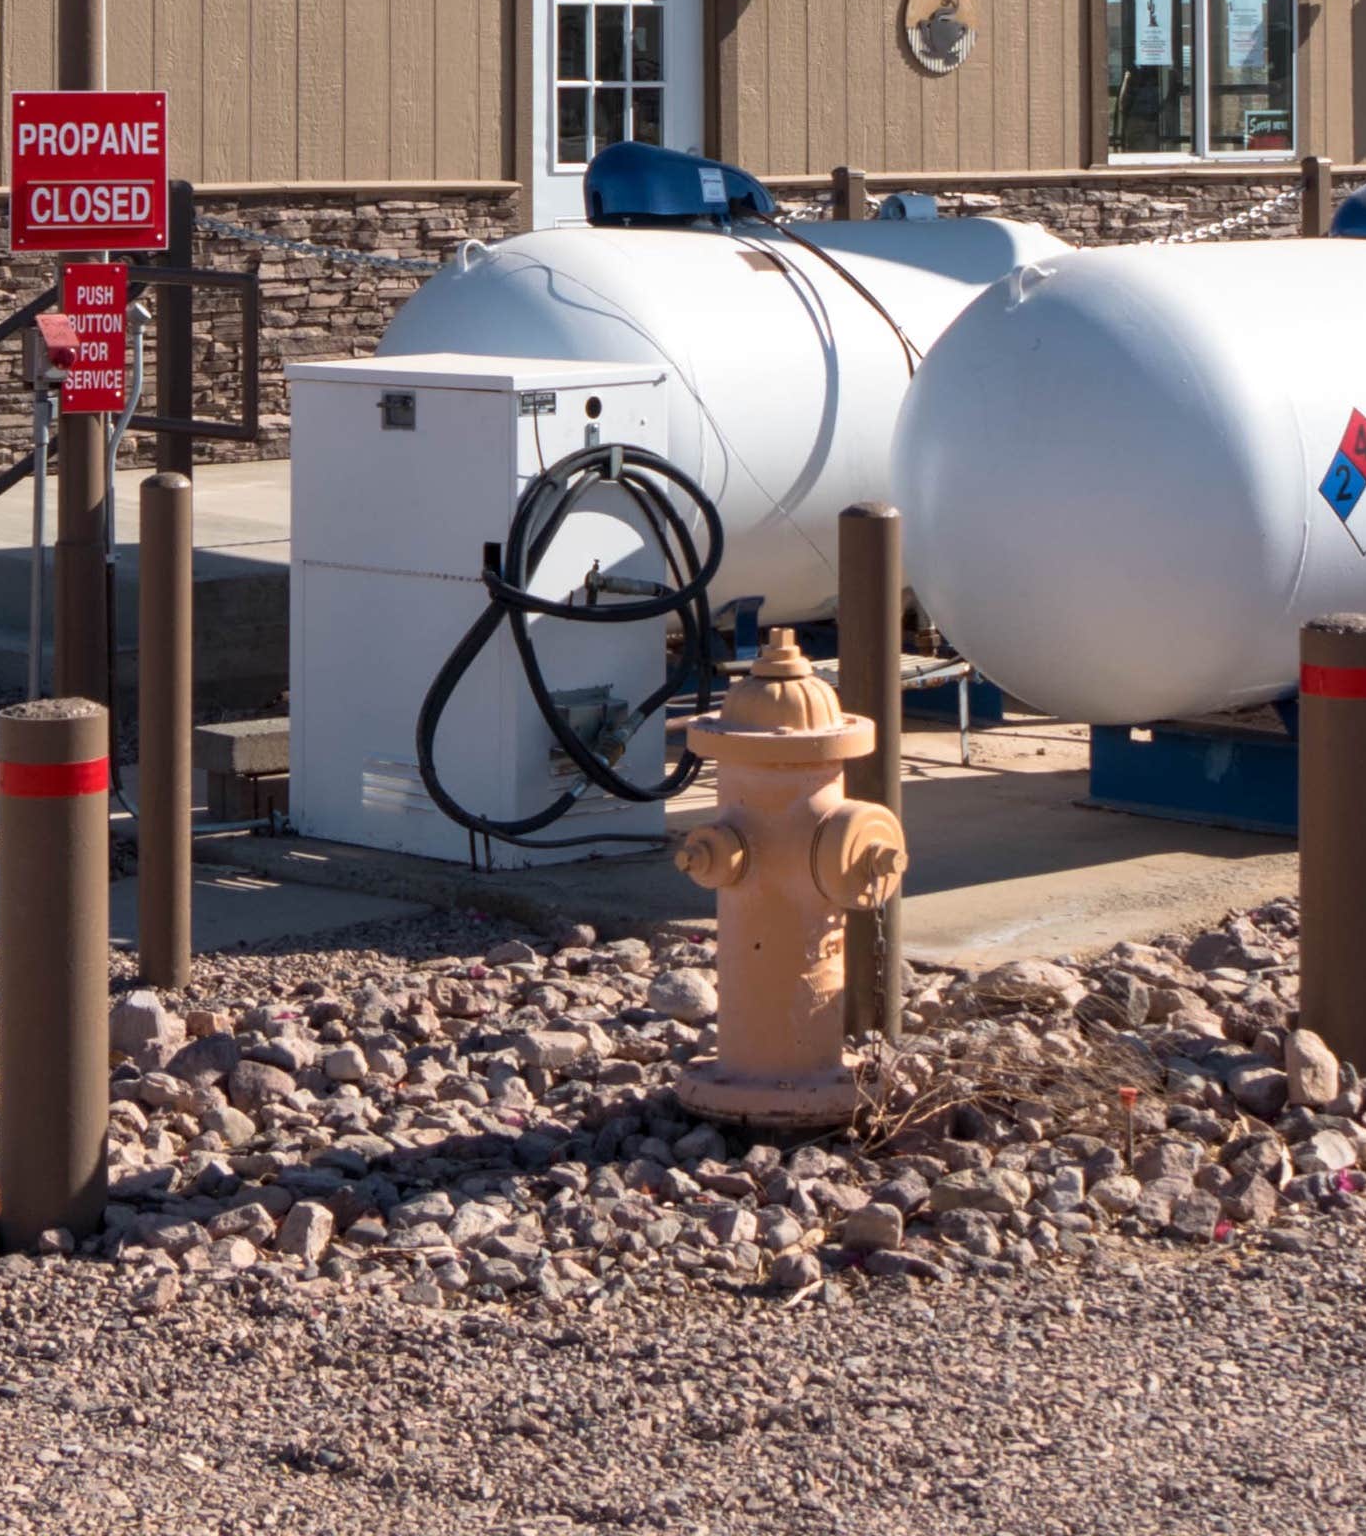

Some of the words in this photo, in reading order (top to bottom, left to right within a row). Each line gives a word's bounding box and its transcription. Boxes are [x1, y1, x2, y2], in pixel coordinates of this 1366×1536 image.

[19, 122, 159, 156] PROPANE
[30, 187, 151, 223] CLOSED
[76, 286, 114, 305] PUSH
[81, 342, 108, 362] FOR
[65, 370, 123, 390] SERVICE
[1335, 465, 1352, 502] 2
